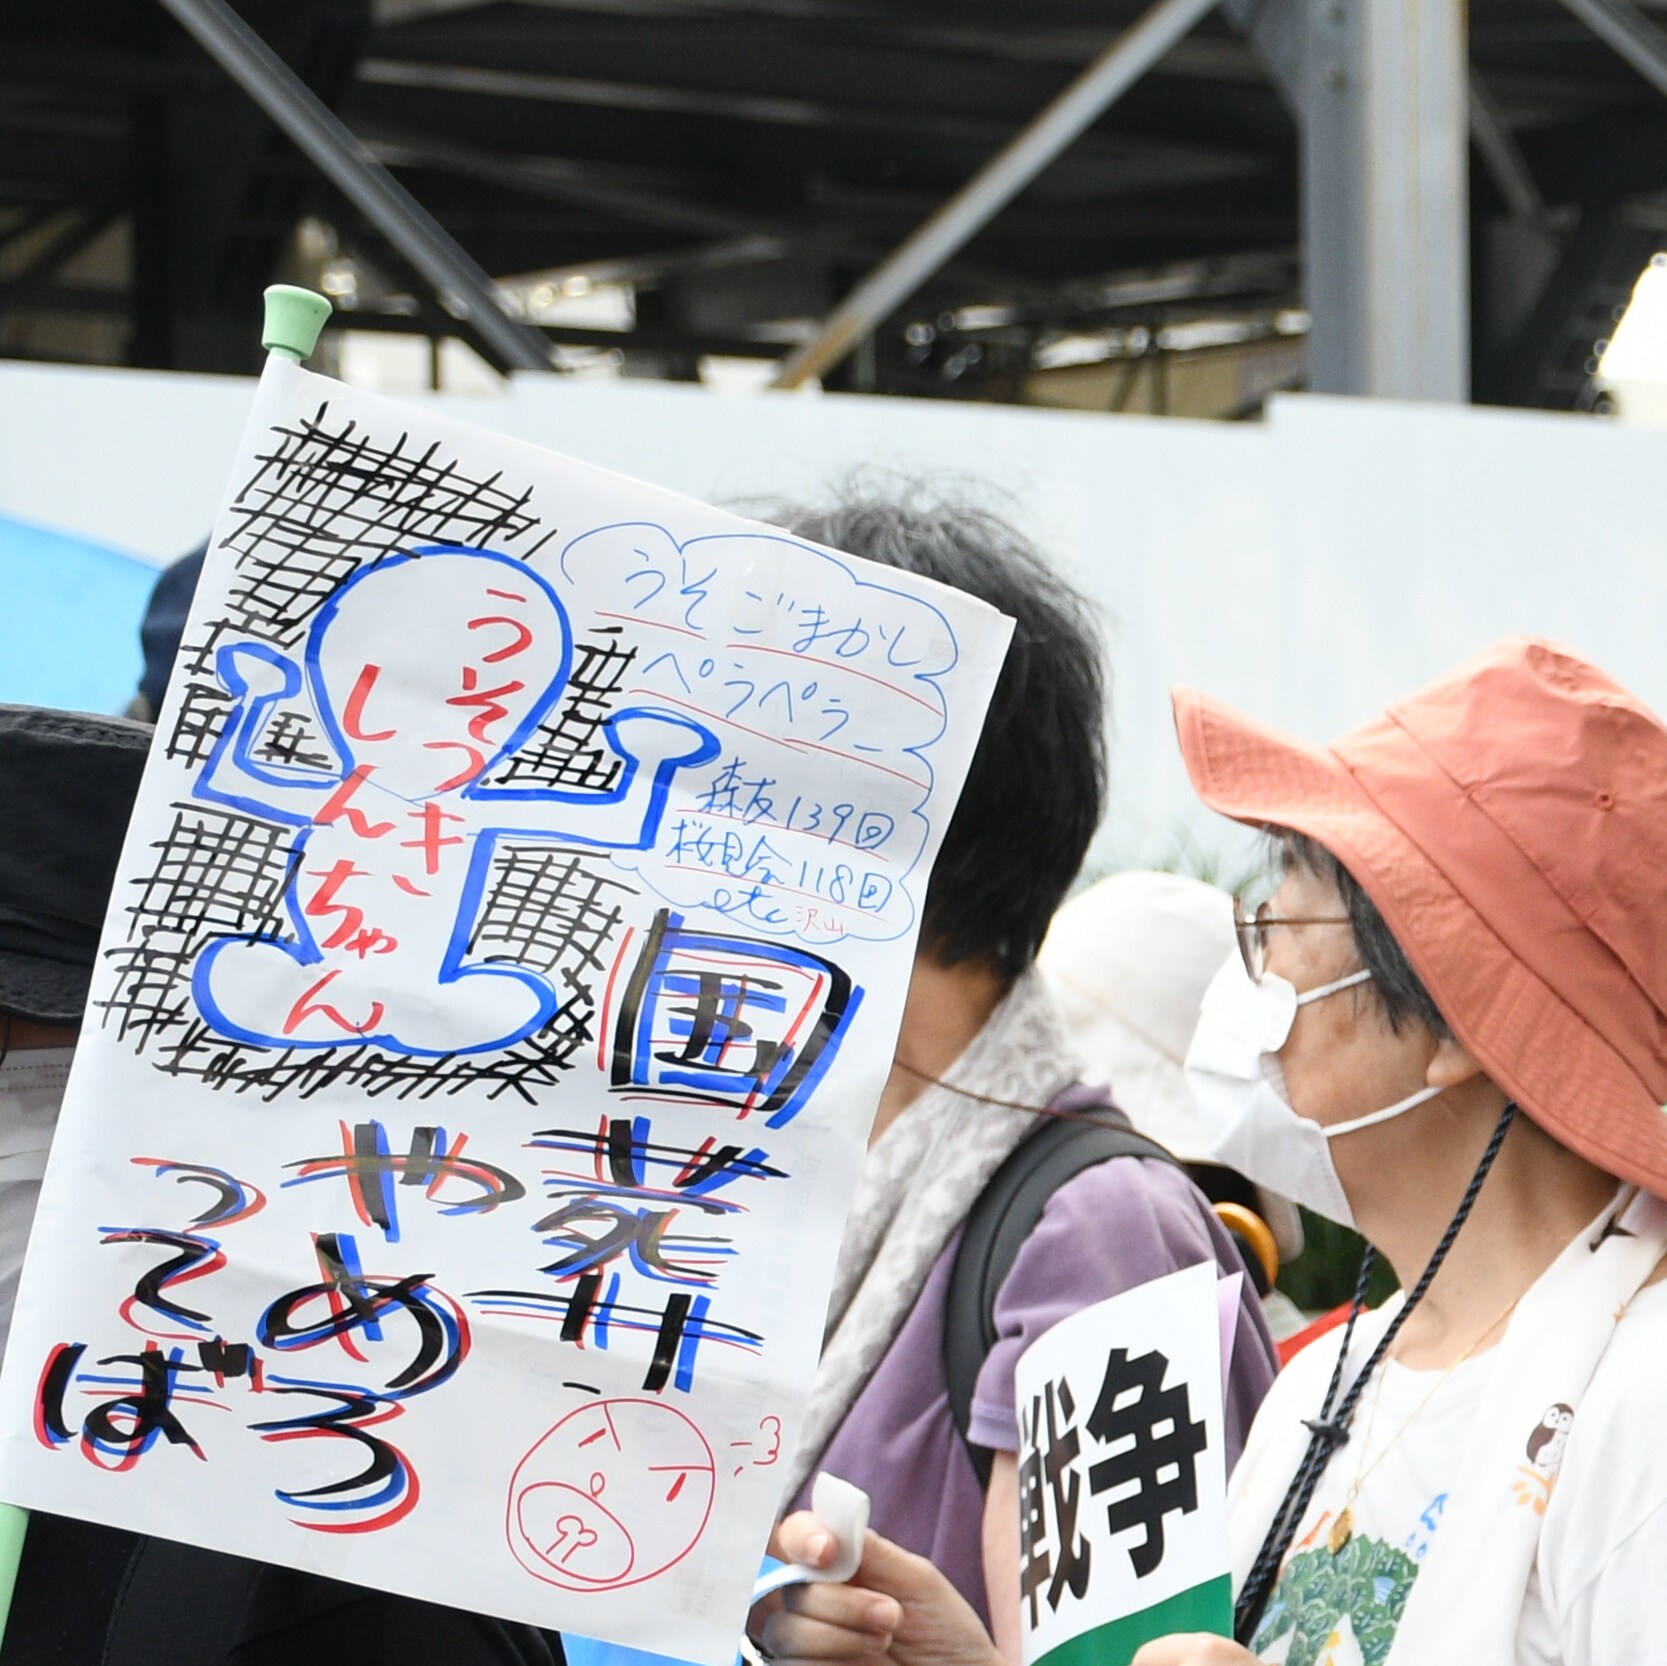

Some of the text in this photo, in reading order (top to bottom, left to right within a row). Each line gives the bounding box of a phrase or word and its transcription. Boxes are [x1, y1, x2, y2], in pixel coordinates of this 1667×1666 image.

[624, 547, 921, 666] うそ ごまかし
[1020, 1346, 1208, 1630] 戦争
